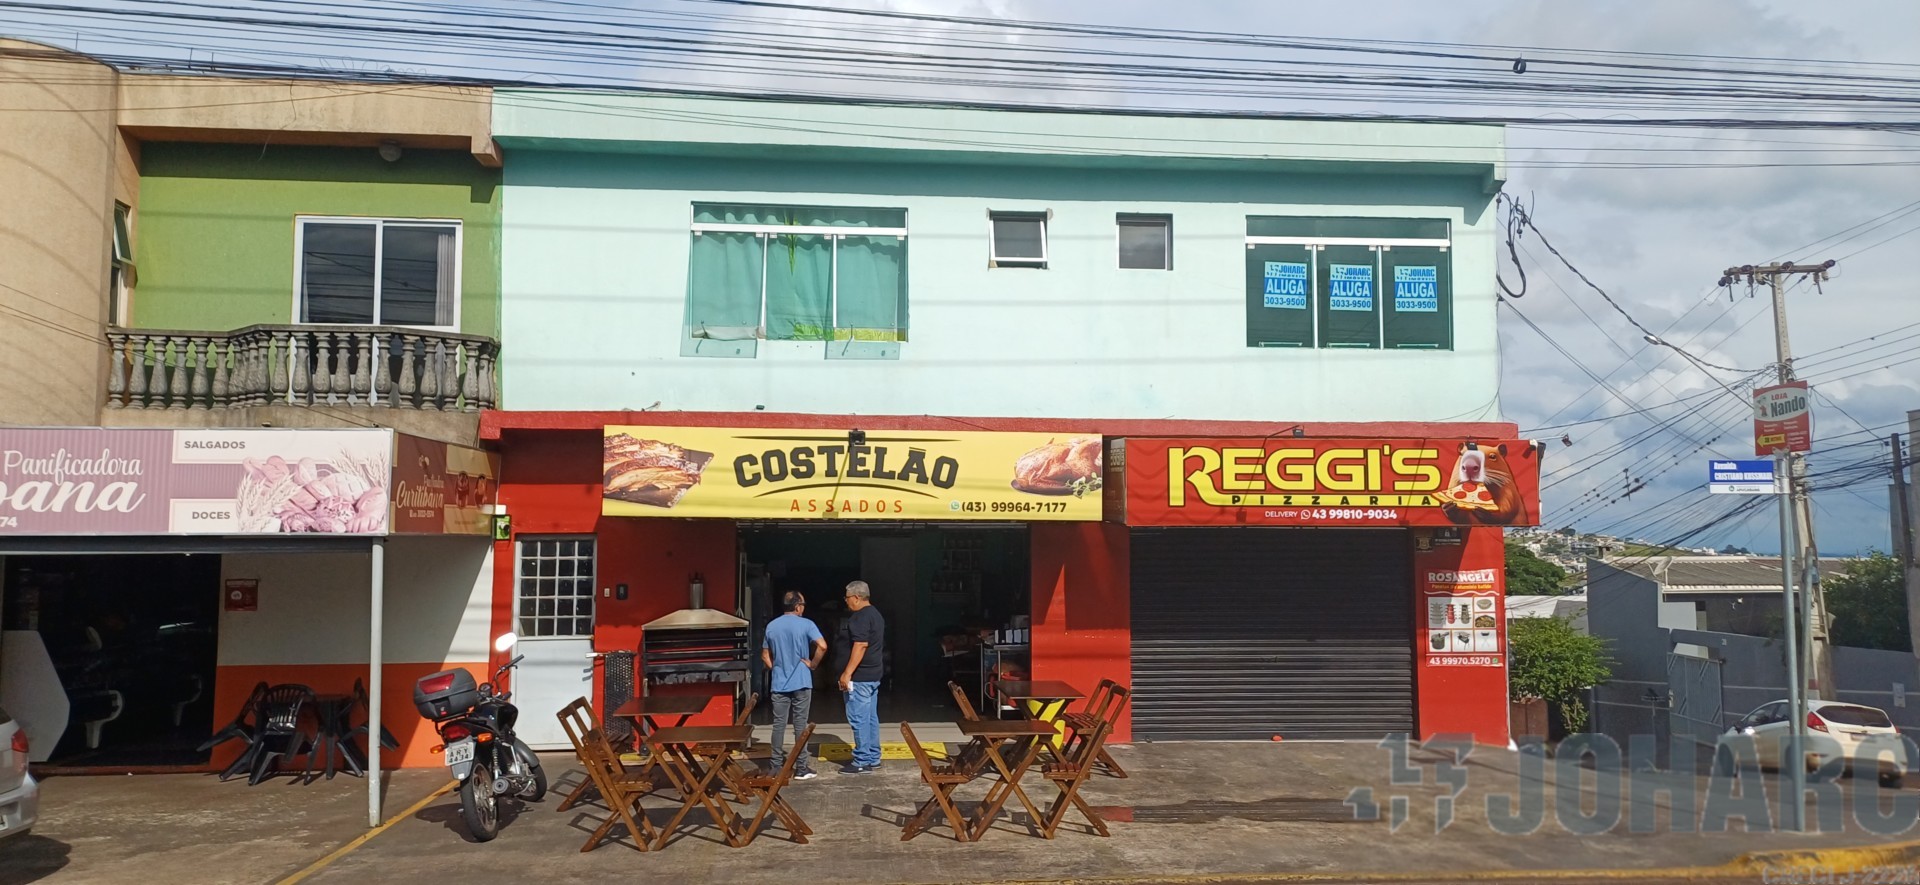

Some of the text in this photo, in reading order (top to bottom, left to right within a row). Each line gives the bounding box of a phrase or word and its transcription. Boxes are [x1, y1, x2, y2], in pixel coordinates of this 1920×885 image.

[1266, 278, 1305, 294] ALUGA
[1332, 281, 1371, 297] ALUGA
[1397, 282, 1436, 298] ALUGA
[1265, 296, 1306, 306] 3033-9500
[1331, 299, 1371, 309] 3033-9500
[1396, 300, 1437, 310] 3033-9500
[1771, 392, 1788, 400] LOJA
[1770, 396, 1806, 418] Nando
[184, 441, 246, 449] SALGADOS
[4, 448, 143, 486] Panificadora
[733, 445, 959, 490] COSTELÃO
[1168, 445, 1442, 507] REGGI'S
[790, 499, 903, 513] ASSADOS
[1231, 495, 1431, 506] PIZZARIA
[962, 502, 1067, 513] (43) 99964-7177
[192, 511, 231, 520] DOCES
[1312, 509, 1327, 519] 43
[1329, 509, 1398, 520] 99810-9034
[1428, 572, 1495, 583] ROSANGELA
[1430, 657, 1491, 665] 43 99970.5270
